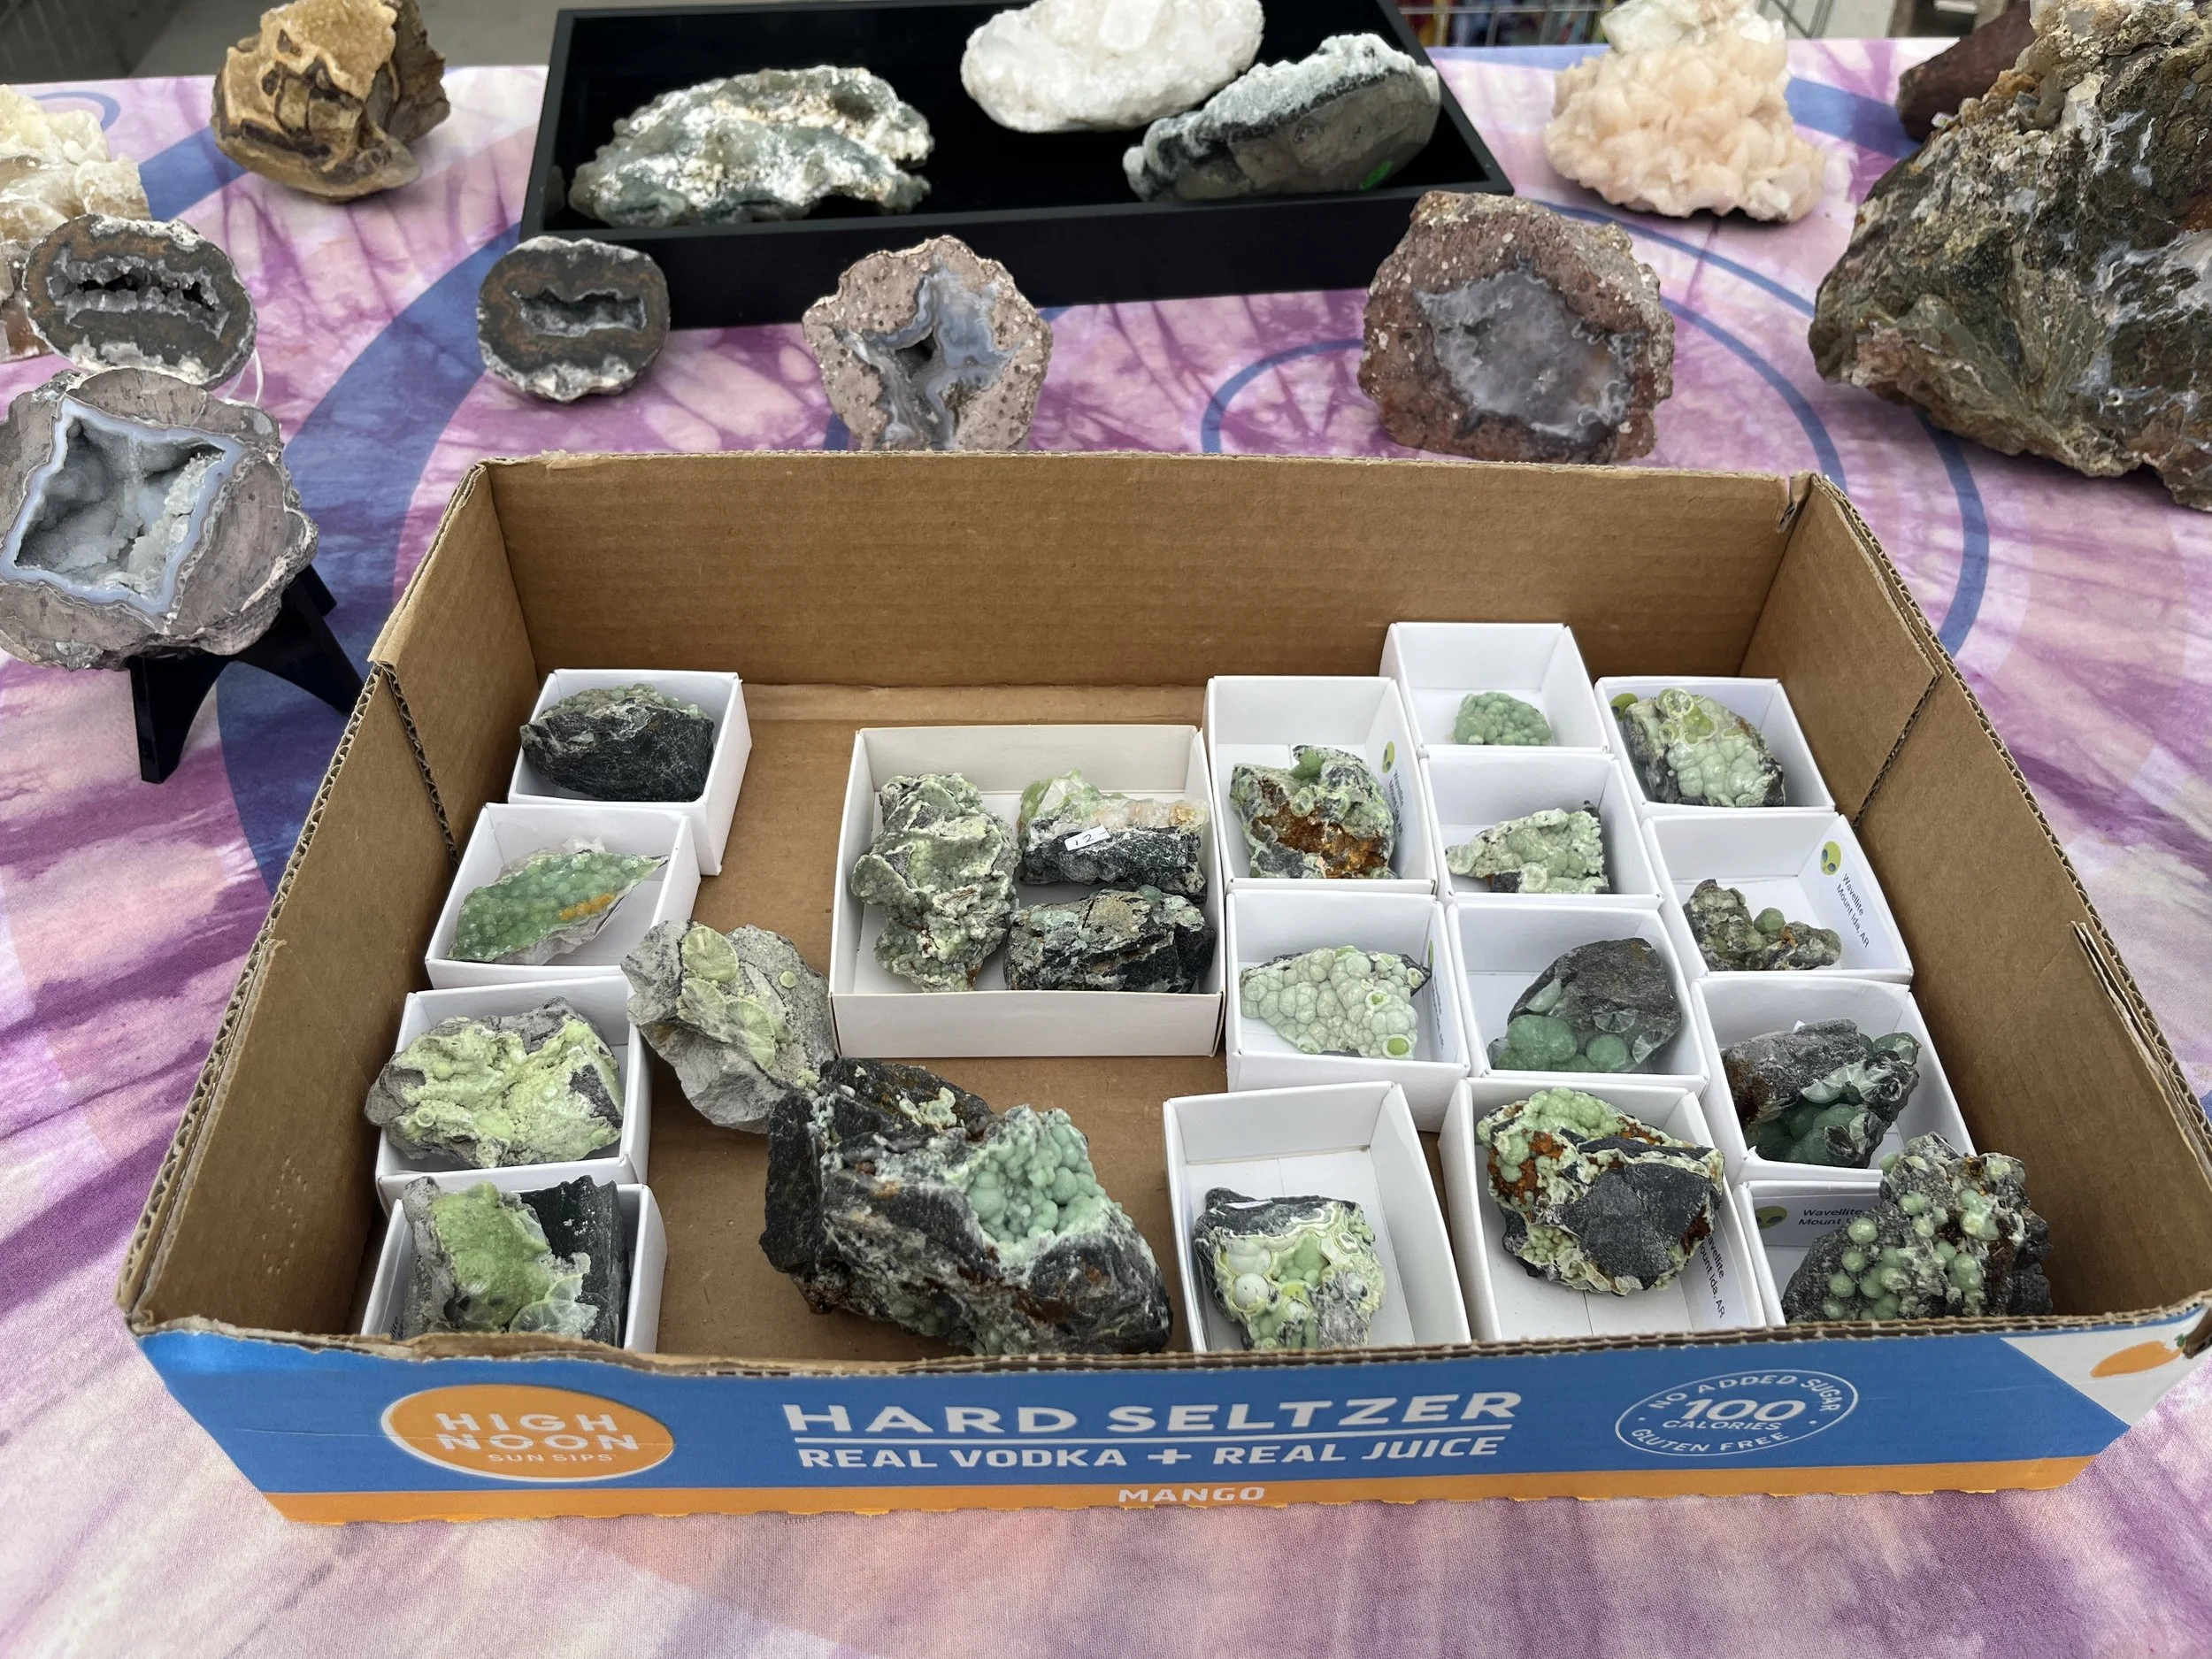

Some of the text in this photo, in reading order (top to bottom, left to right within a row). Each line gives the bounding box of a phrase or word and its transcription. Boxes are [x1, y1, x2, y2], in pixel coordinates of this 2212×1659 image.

[1843, 872, 1864, 917] Wavellite
[1837, 883, 1854, 916] Mount
[1860, 932, 1870, 949] AR
[1803, 1208, 1863, 1217] Wavellite
[1708, 1234, 1724, 1279] avellite
[1716, 1299, 1725, 1318] AR
[1647, 1375, 1843, 1412] NO ADDED SUGAR
[782, 1391, 1522, 1433] HARD SELTZER
[1680, 1398, 1807, 1422] 100
[434, 1413, 618, 1432] HIGH
[1663, 1420, 1783, 1431] CALORIES
[435, 1433, 640, 1451] NOON
[797, 1448, 939, 1468] REAL
[949, 1448, 1128, 1468] VODKA
[1212, 1442, 1347, 1465] REAL
[1361, 1435, 1506, 1461] JUICE
[1631, 1428, 1790, 1452] GLUTEN FREE
[488, 1454, 614, 1463] SUN SIPS
[1118, 1486, 1266, 1502] MANGO
